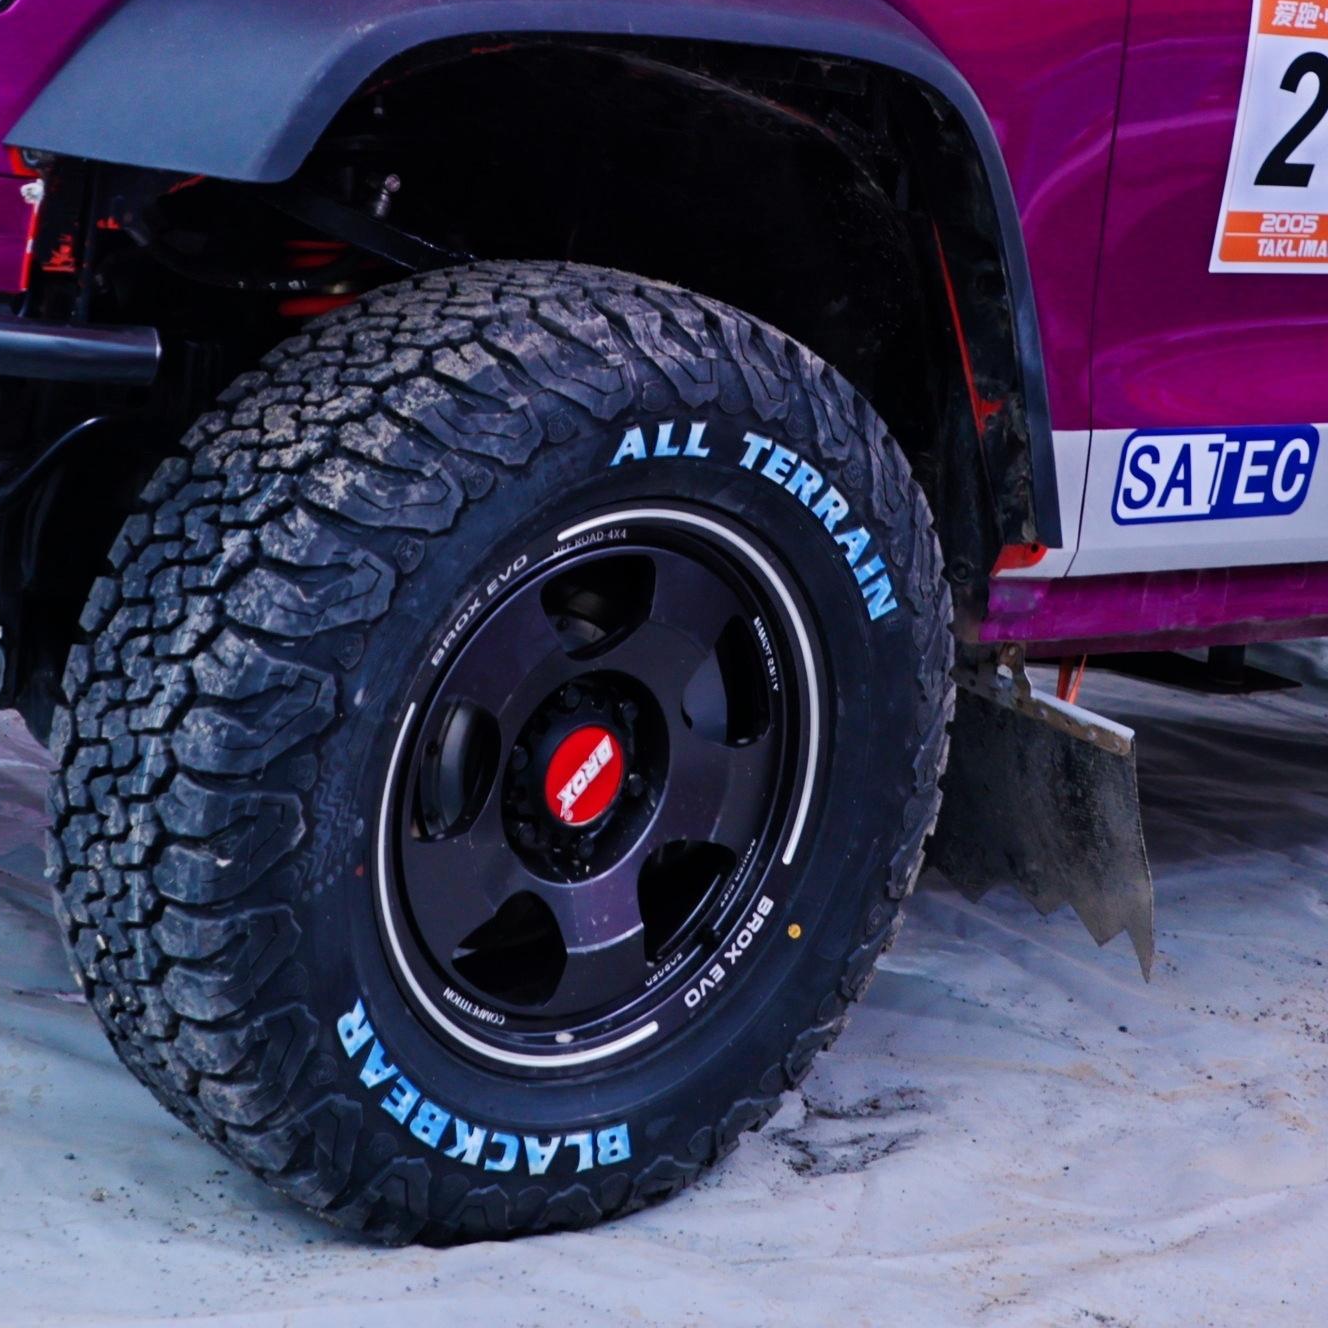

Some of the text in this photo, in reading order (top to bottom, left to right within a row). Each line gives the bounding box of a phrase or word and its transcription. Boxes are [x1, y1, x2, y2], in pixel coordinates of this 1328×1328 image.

[1259, 213, 1320, 234] 2005
[609, 419, 903, 622] ALL TERRAIN
[1121, 432, 1311, 512] SATEC
[430, 554, 530, 668] BROX EVO
[556, 733, 615, 819] BROX
[683, 895, 775, 1009] BROX EVO
[442, 986, 506, 1026] COMPETITION
[335, 996, 632, 1176] BLACKBEAR
